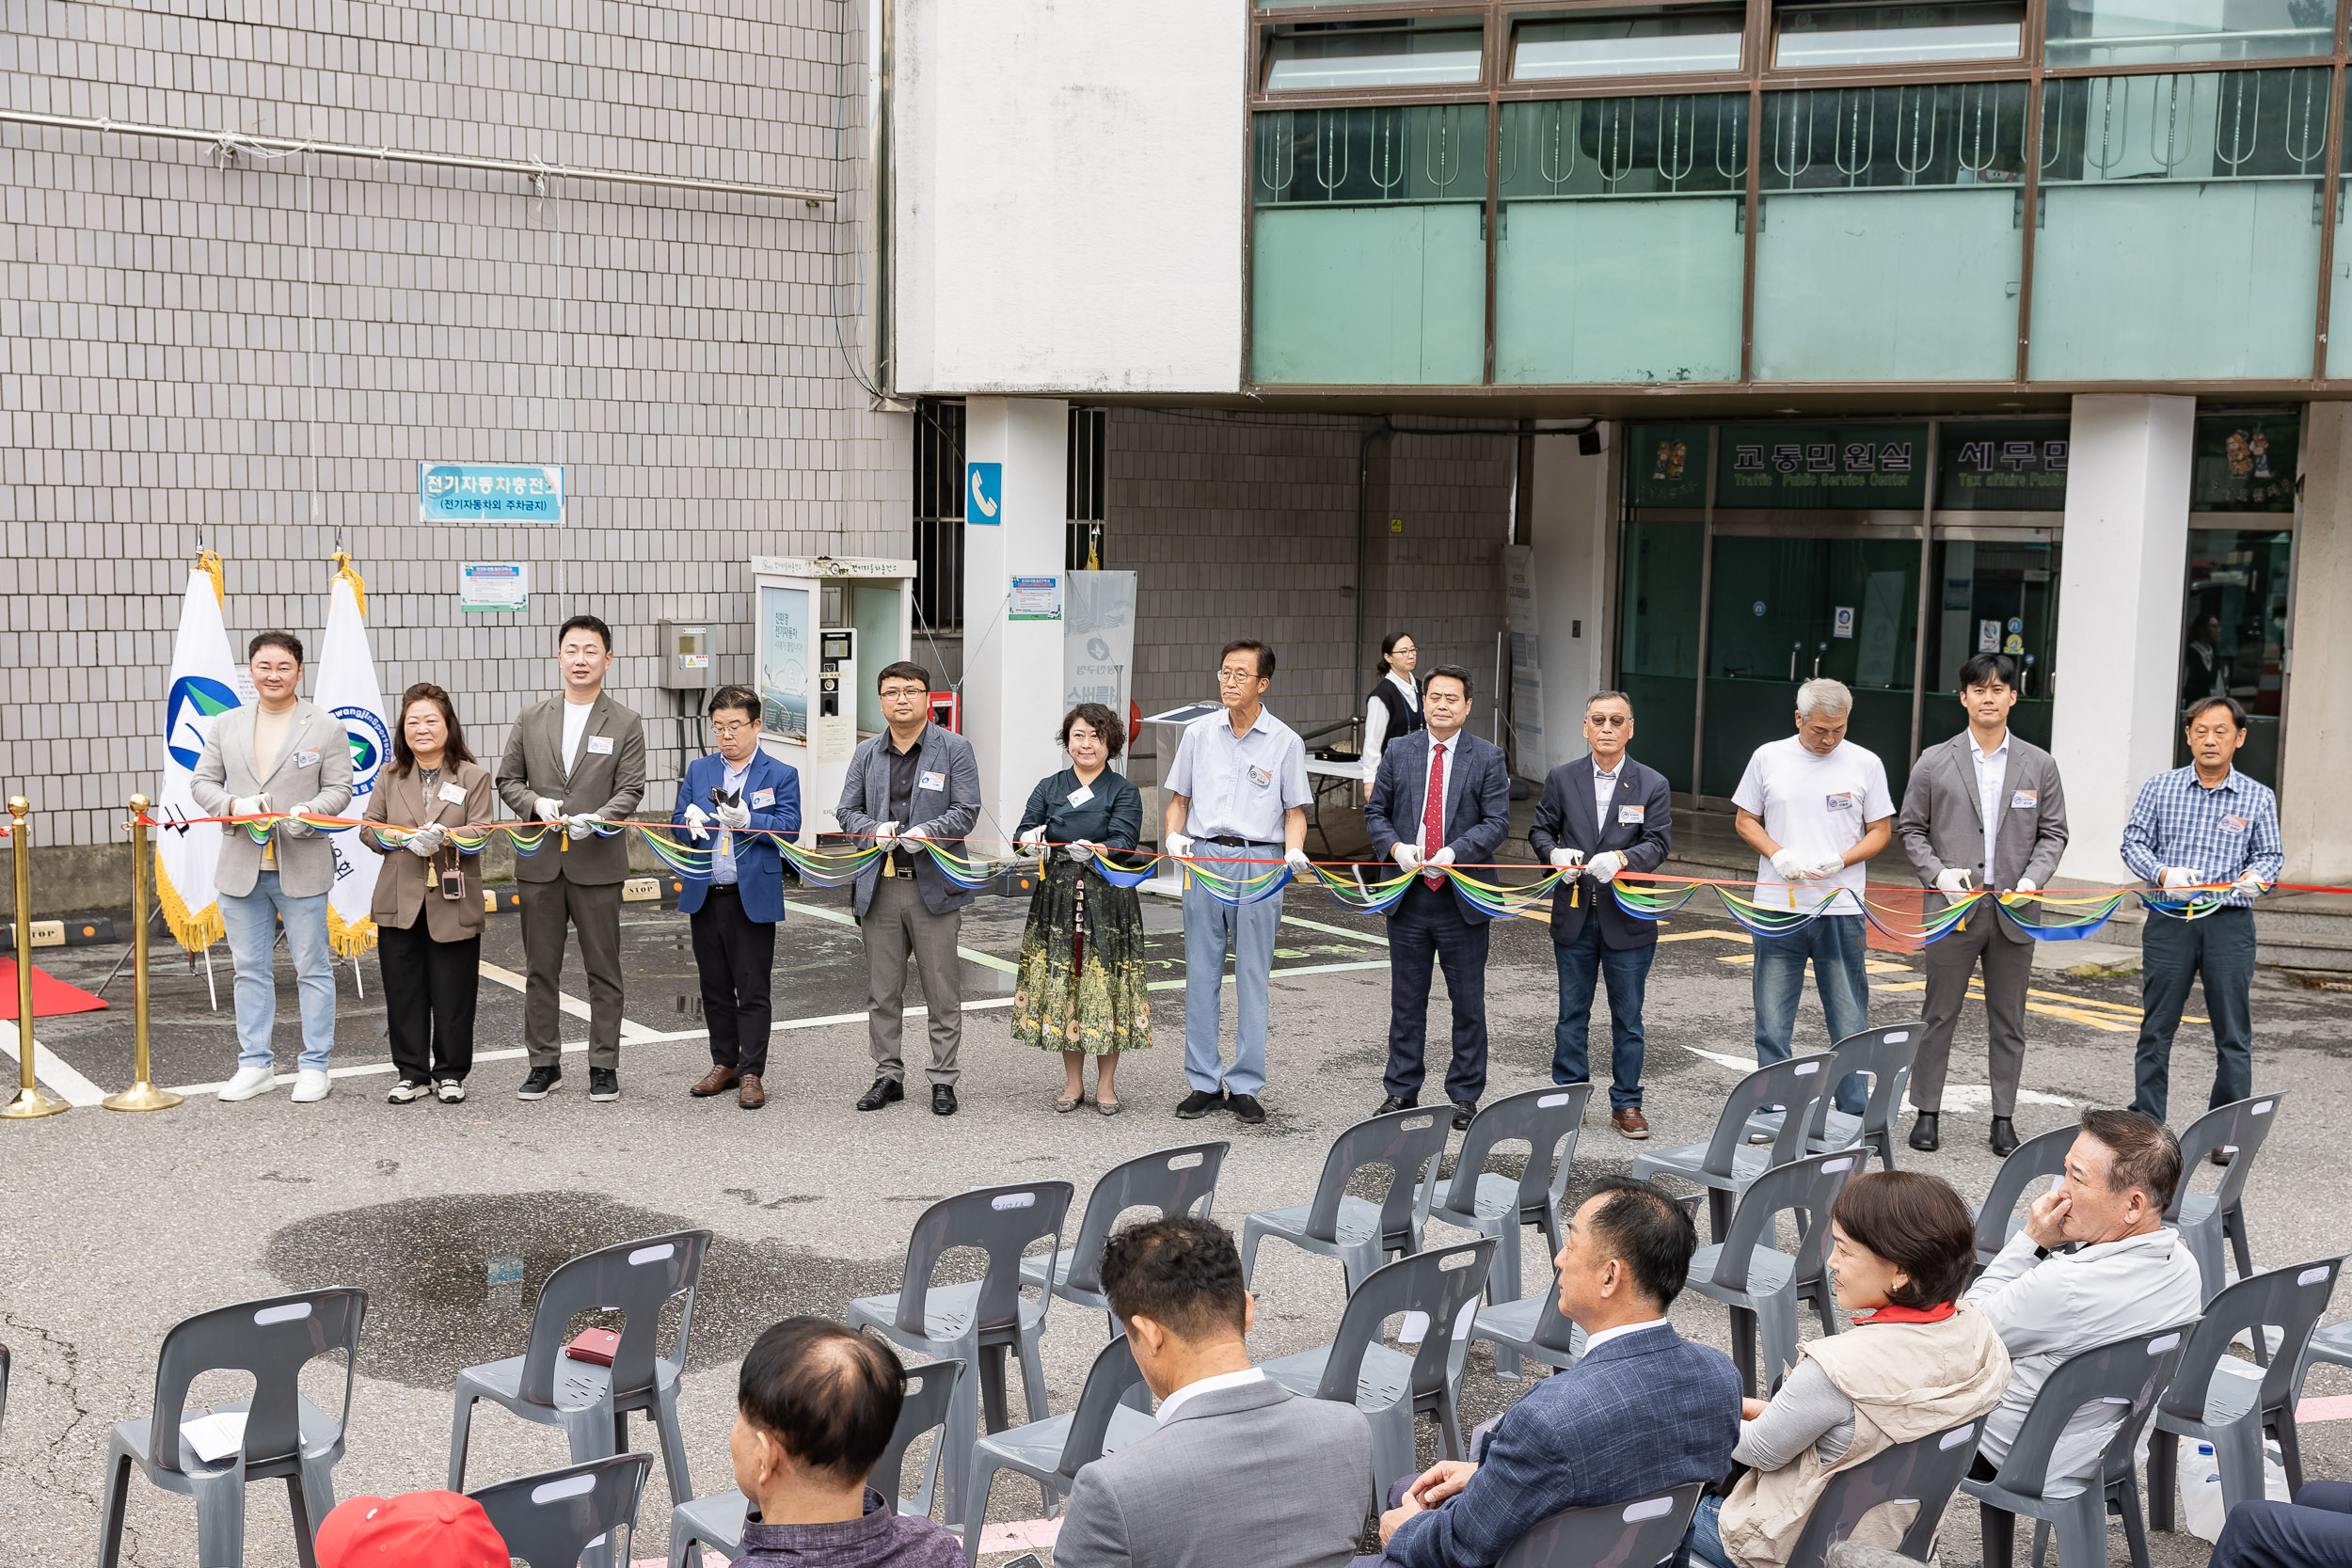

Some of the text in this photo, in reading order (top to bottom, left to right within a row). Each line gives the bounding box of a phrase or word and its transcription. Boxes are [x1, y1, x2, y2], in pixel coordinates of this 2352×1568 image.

[1734, 442, 1912, 472] 교통민원실
[1734, 473, 1911, 487] Traffic Public Service Center
[440, 499, 547, 511] (전기자동차외 주차금지)
[775, 626, 798, 641] 전기자동차
